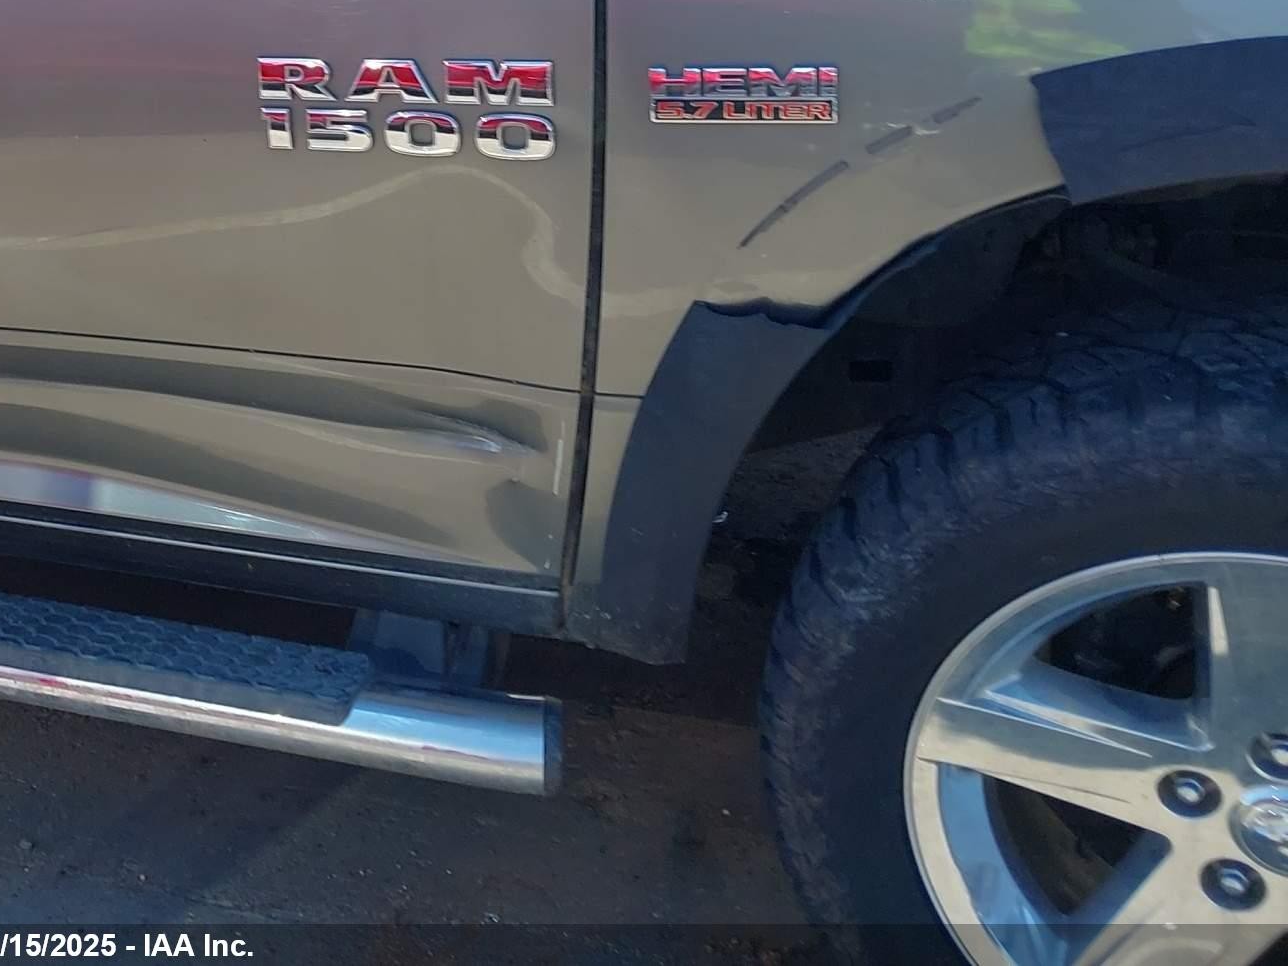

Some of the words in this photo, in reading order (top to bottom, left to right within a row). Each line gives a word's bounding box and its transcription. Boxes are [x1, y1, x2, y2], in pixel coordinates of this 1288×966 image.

[257, 56, 554, 106] RAM
[647, 67, 838, 97] HEMI
[656, 101, 719, 120] 5.7
[722, 101, 833, 121] LITER
[260, 107, 556, 161] 1500
